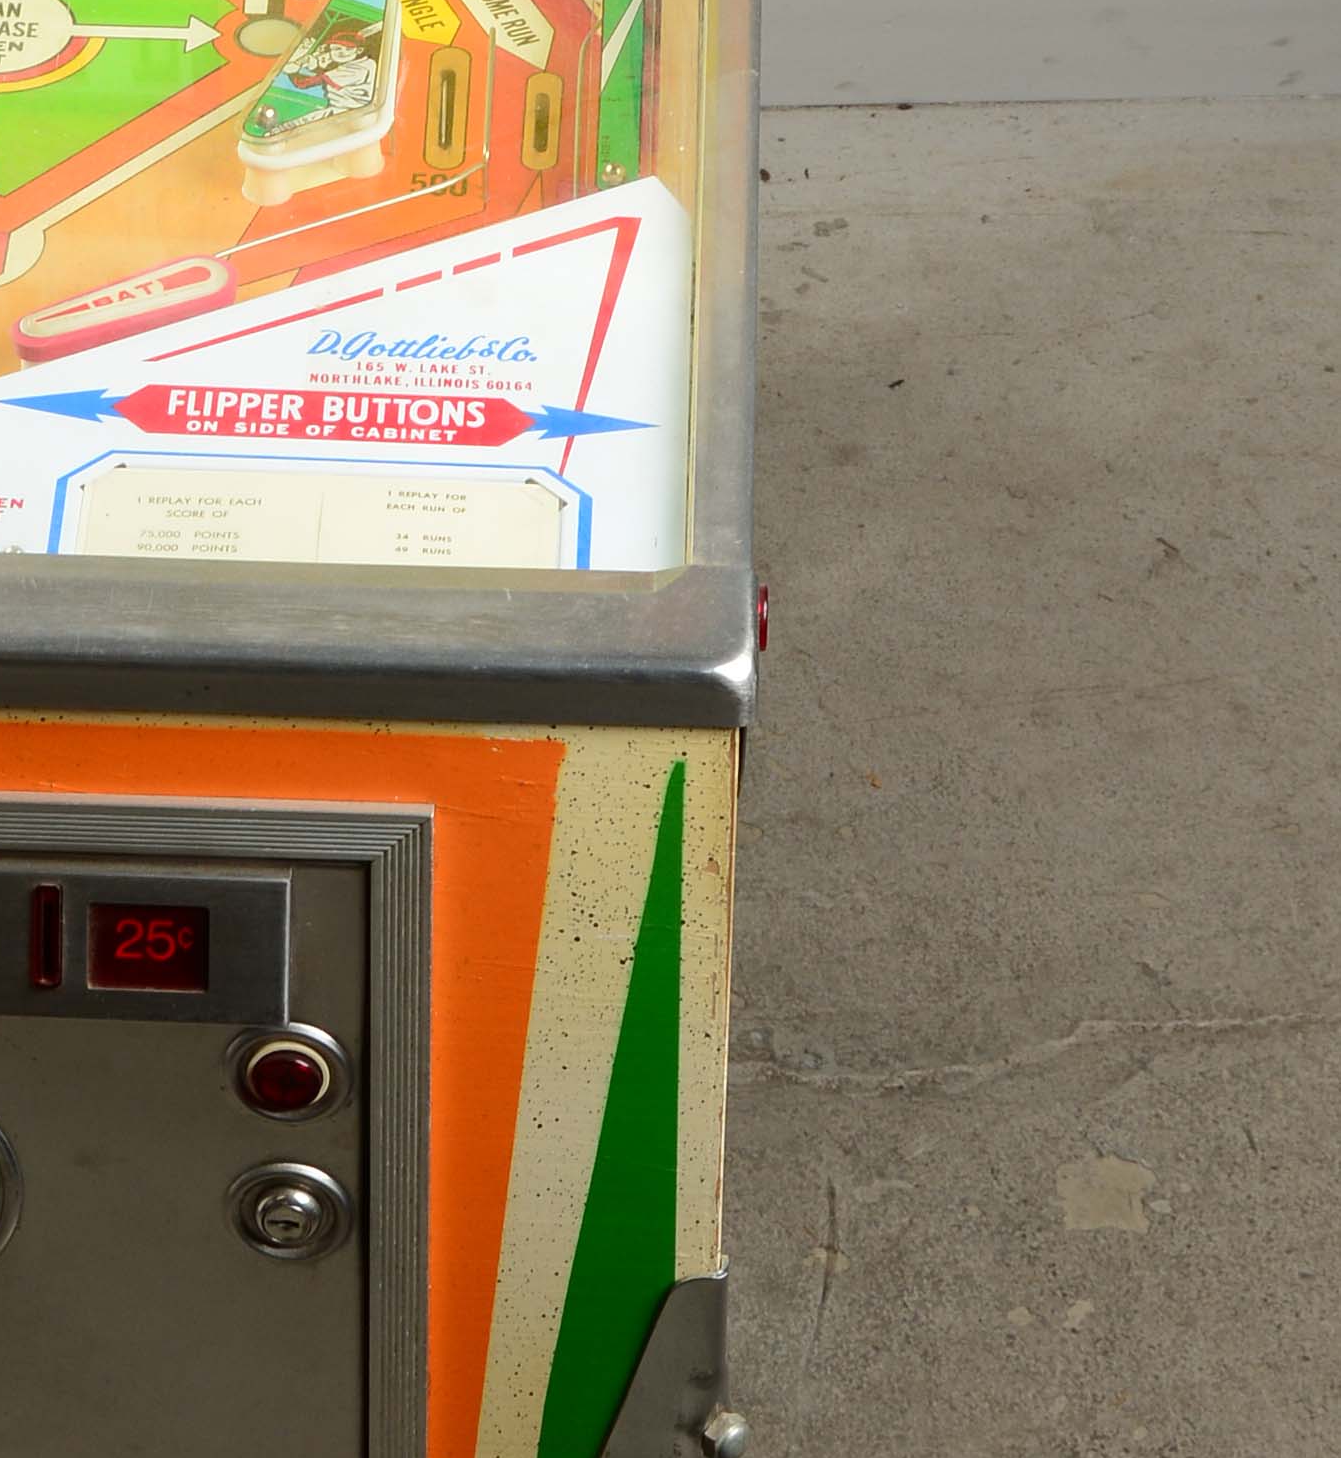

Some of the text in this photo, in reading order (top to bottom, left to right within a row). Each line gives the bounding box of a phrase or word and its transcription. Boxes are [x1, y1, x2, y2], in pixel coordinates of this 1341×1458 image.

[507, 16, 540, 48] RUN
[411, 173, 467, 197] 500
[93, 281, 157, 308] BAT
[357, 361, 491, 376] 165 W. LAKE ST.
[309, 373, 533, 391] NORTHLAKE, ILLINOIS 60164
[167, 389, 486, 429] FLIPPER BUTTONS
[186, 419, 459, 442] ON SIDE OF CABINET
[148, 497, 191, 505] REPLAY
[114, 918, 195, 962] 25¢
